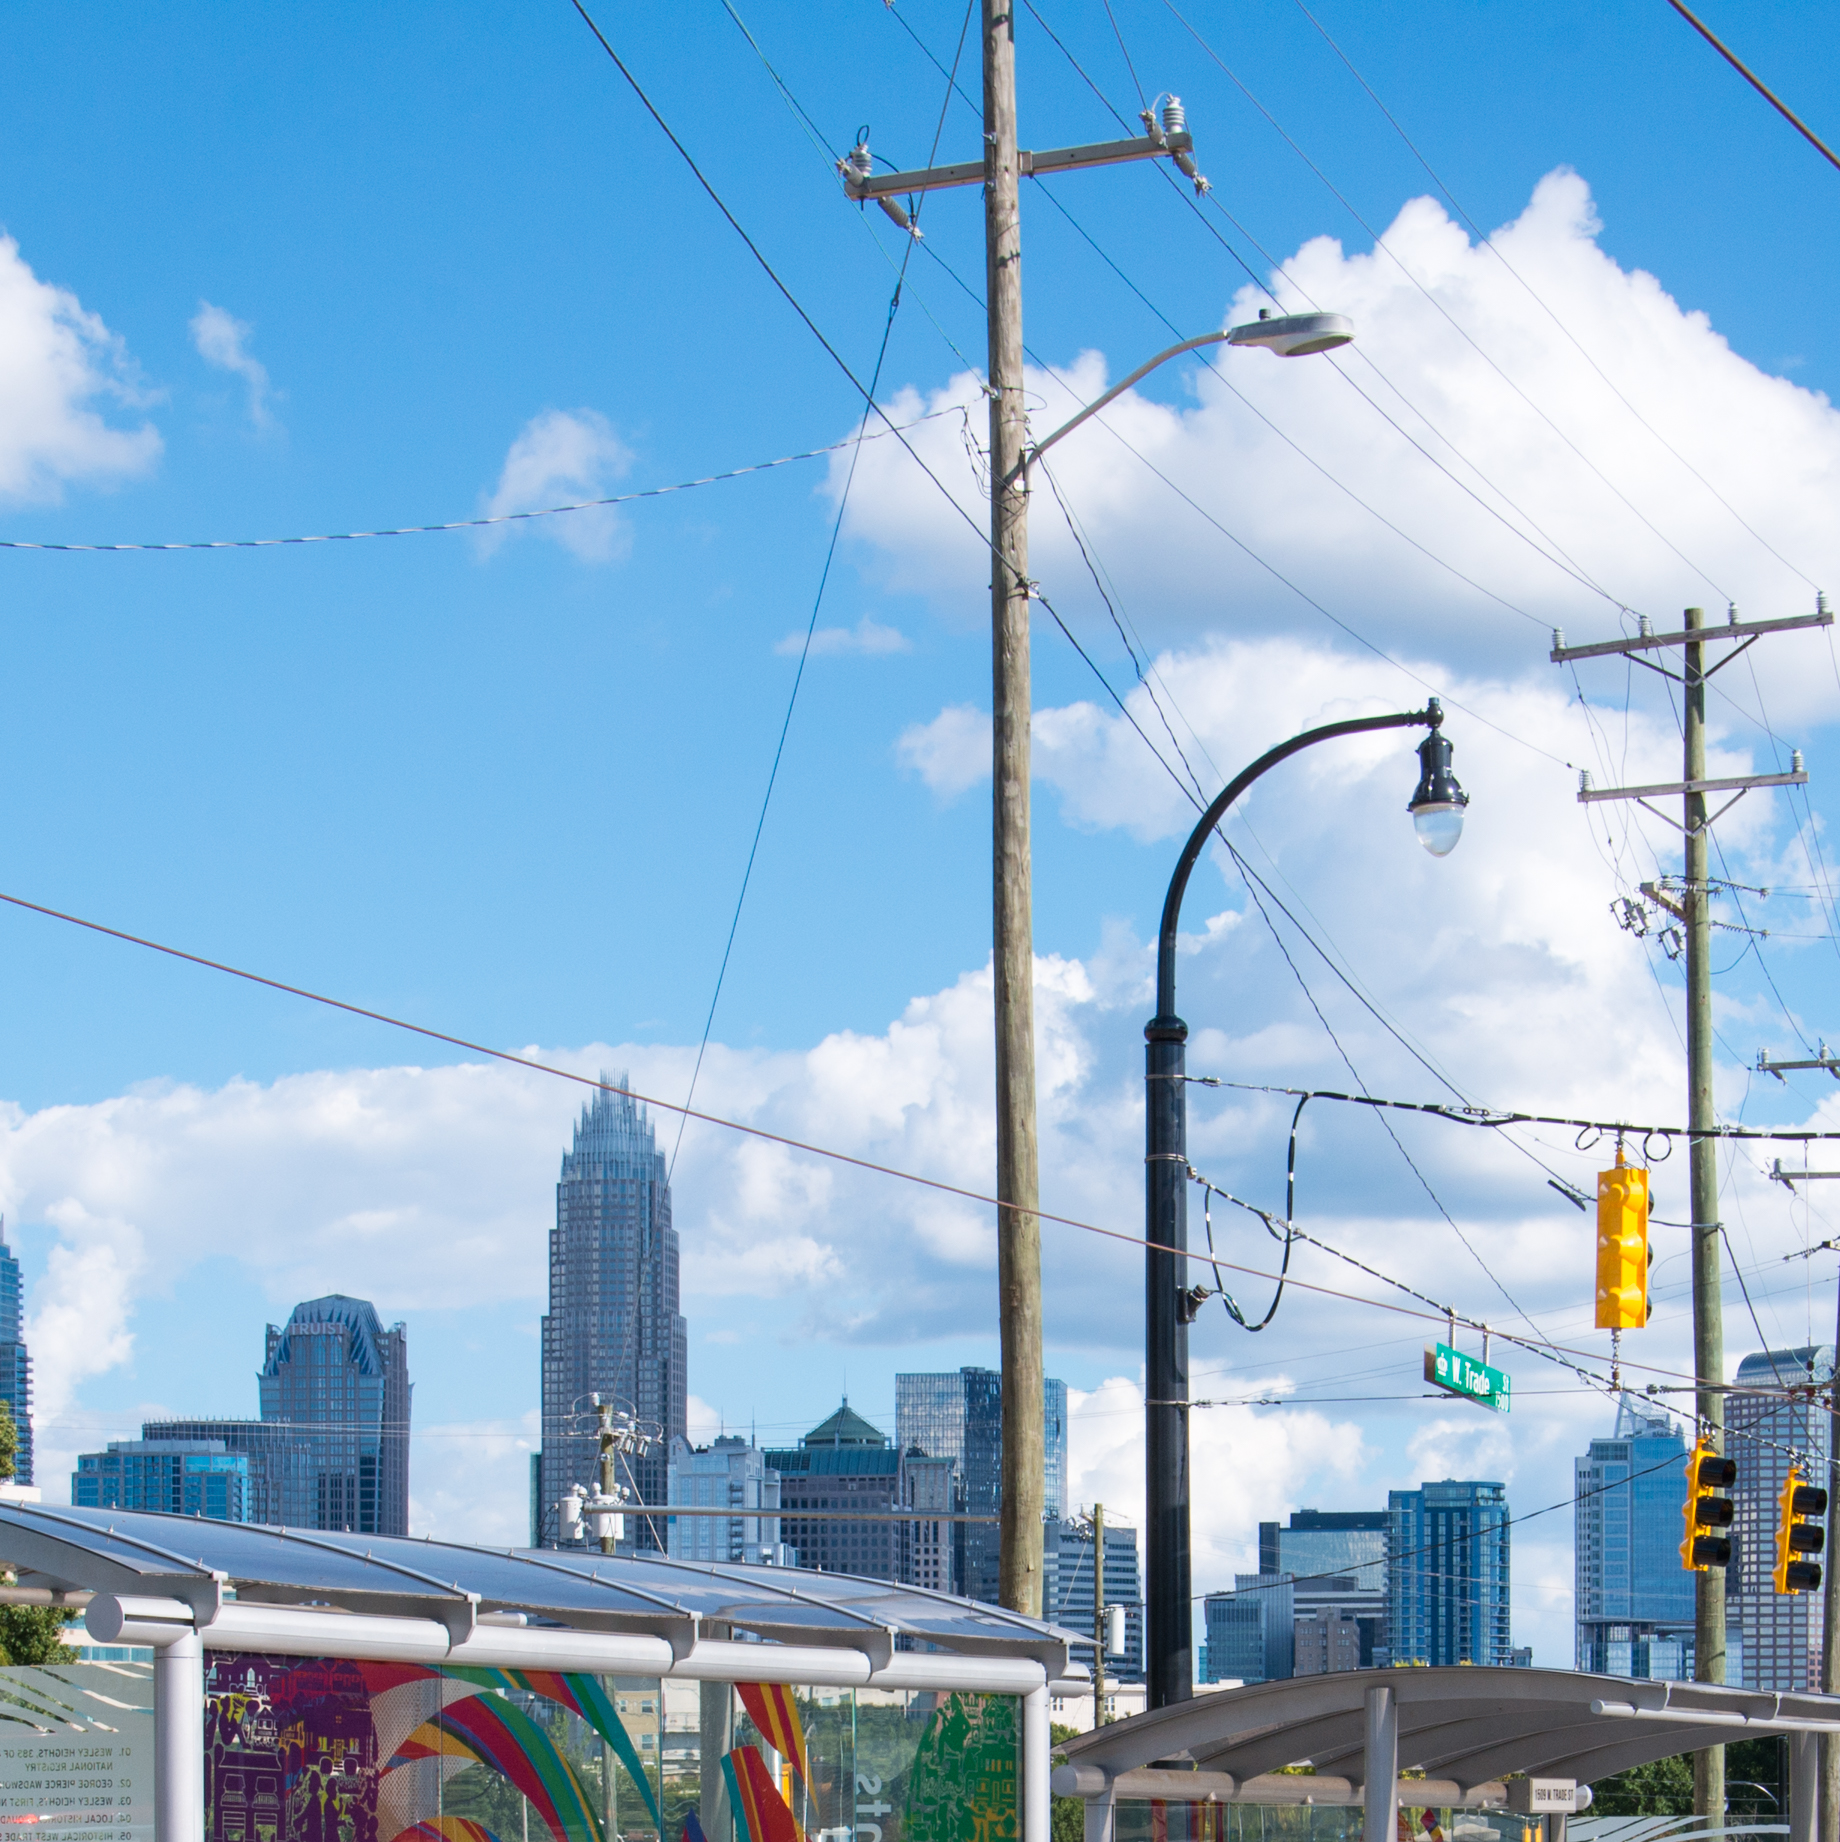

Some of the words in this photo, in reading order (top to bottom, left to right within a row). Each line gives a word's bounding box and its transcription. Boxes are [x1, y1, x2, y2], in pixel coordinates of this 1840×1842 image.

[289, 1322, 346, 1335] TRUIST
[1452, 1355, 1462, 1385] W.
[1465, 1361, 1490, 1396] Trade
[1502, 1374, 1510, 1392] St
[1495, 1391, 1510, 1412] 1500
[1535, 1788, 1546, 1801] 1509
[1553, 1788, 1568, 1801] TRADE
[1568, 1788, 1574, 1801] ST
